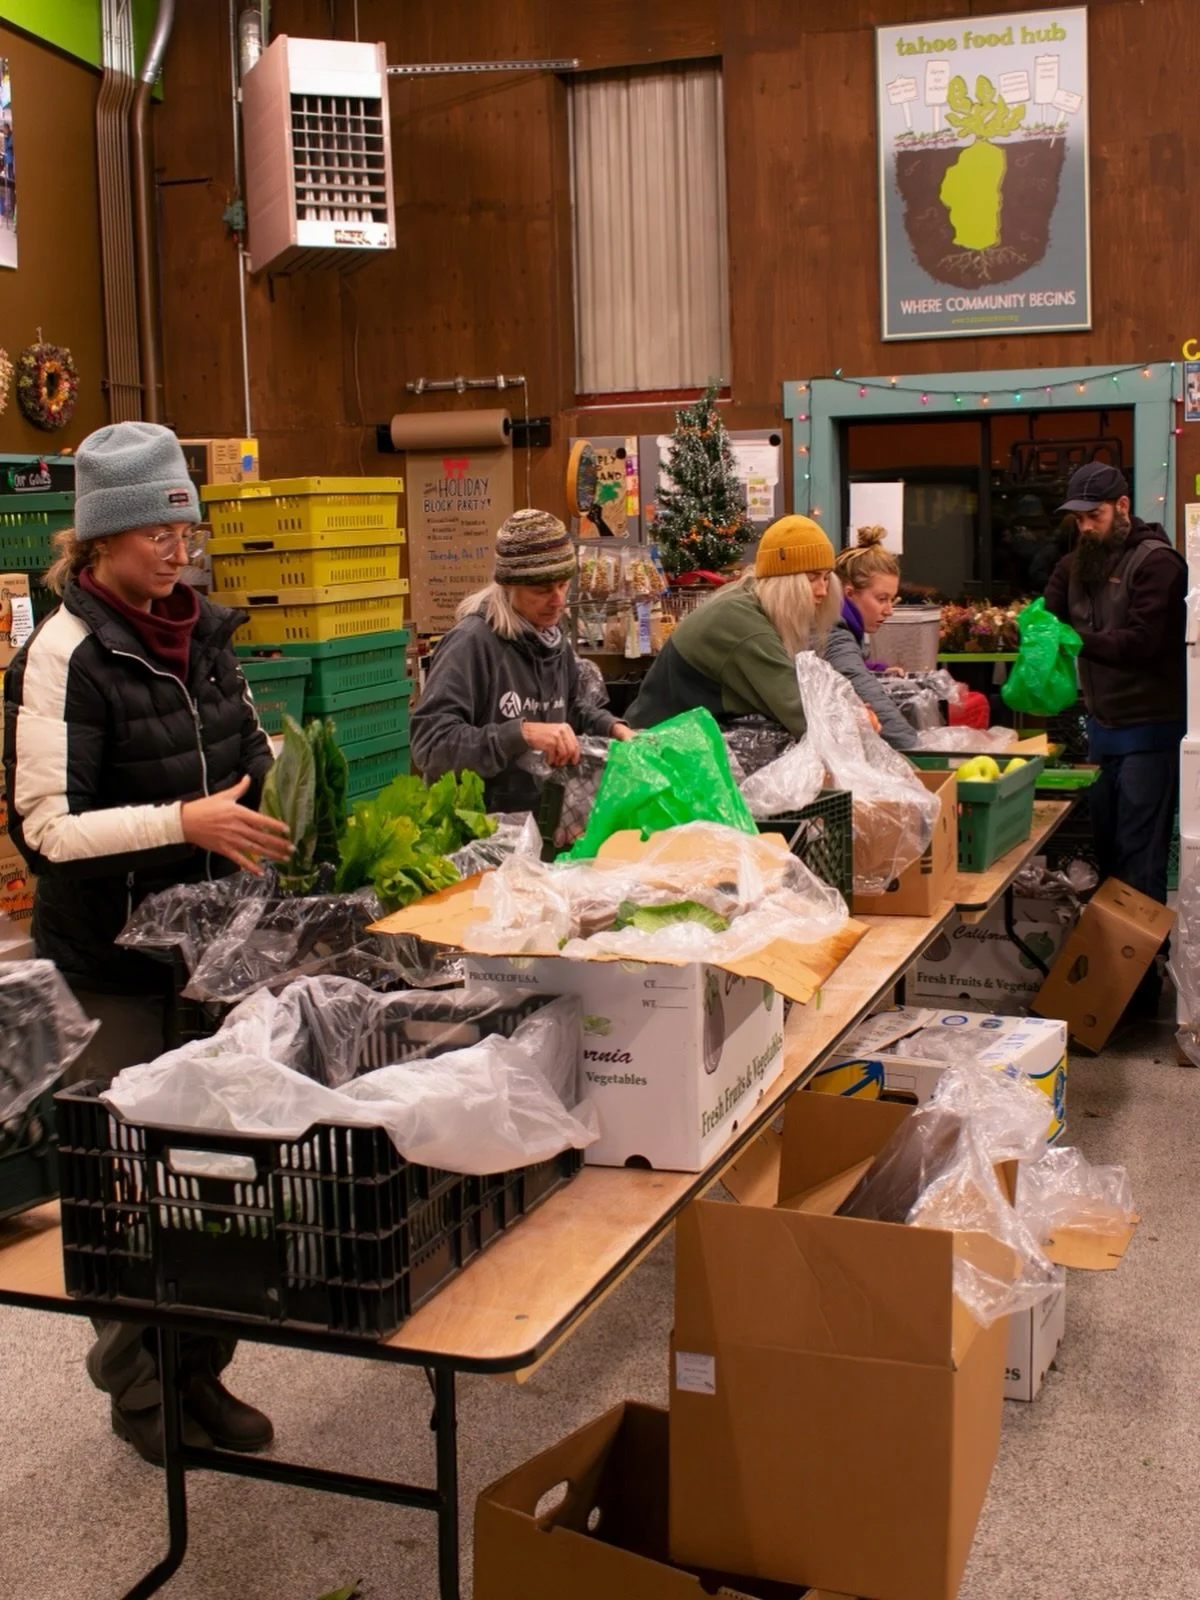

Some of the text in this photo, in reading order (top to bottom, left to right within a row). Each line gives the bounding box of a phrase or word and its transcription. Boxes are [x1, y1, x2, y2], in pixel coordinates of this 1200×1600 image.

[896, 22, 1067, 56] tahoe food hub
[900, 291, 1076, 314] WHERE COMMUNITY BEGINS
[438, 478, 489, 498] HOLIDAY
[424, 499, 454, 512] BLOCK
[952, 925, 1011, 943] Californ
[917, 971, 1040, 993] Fresh Fruits & Vegetab
[585, 1071, 648, 1086] Vegetables
[701, 1096, 724, 1138] Fresh
[724, 1076, 746, 1113] Fruits
[752, 1032, 783, 1080] Vegetables
